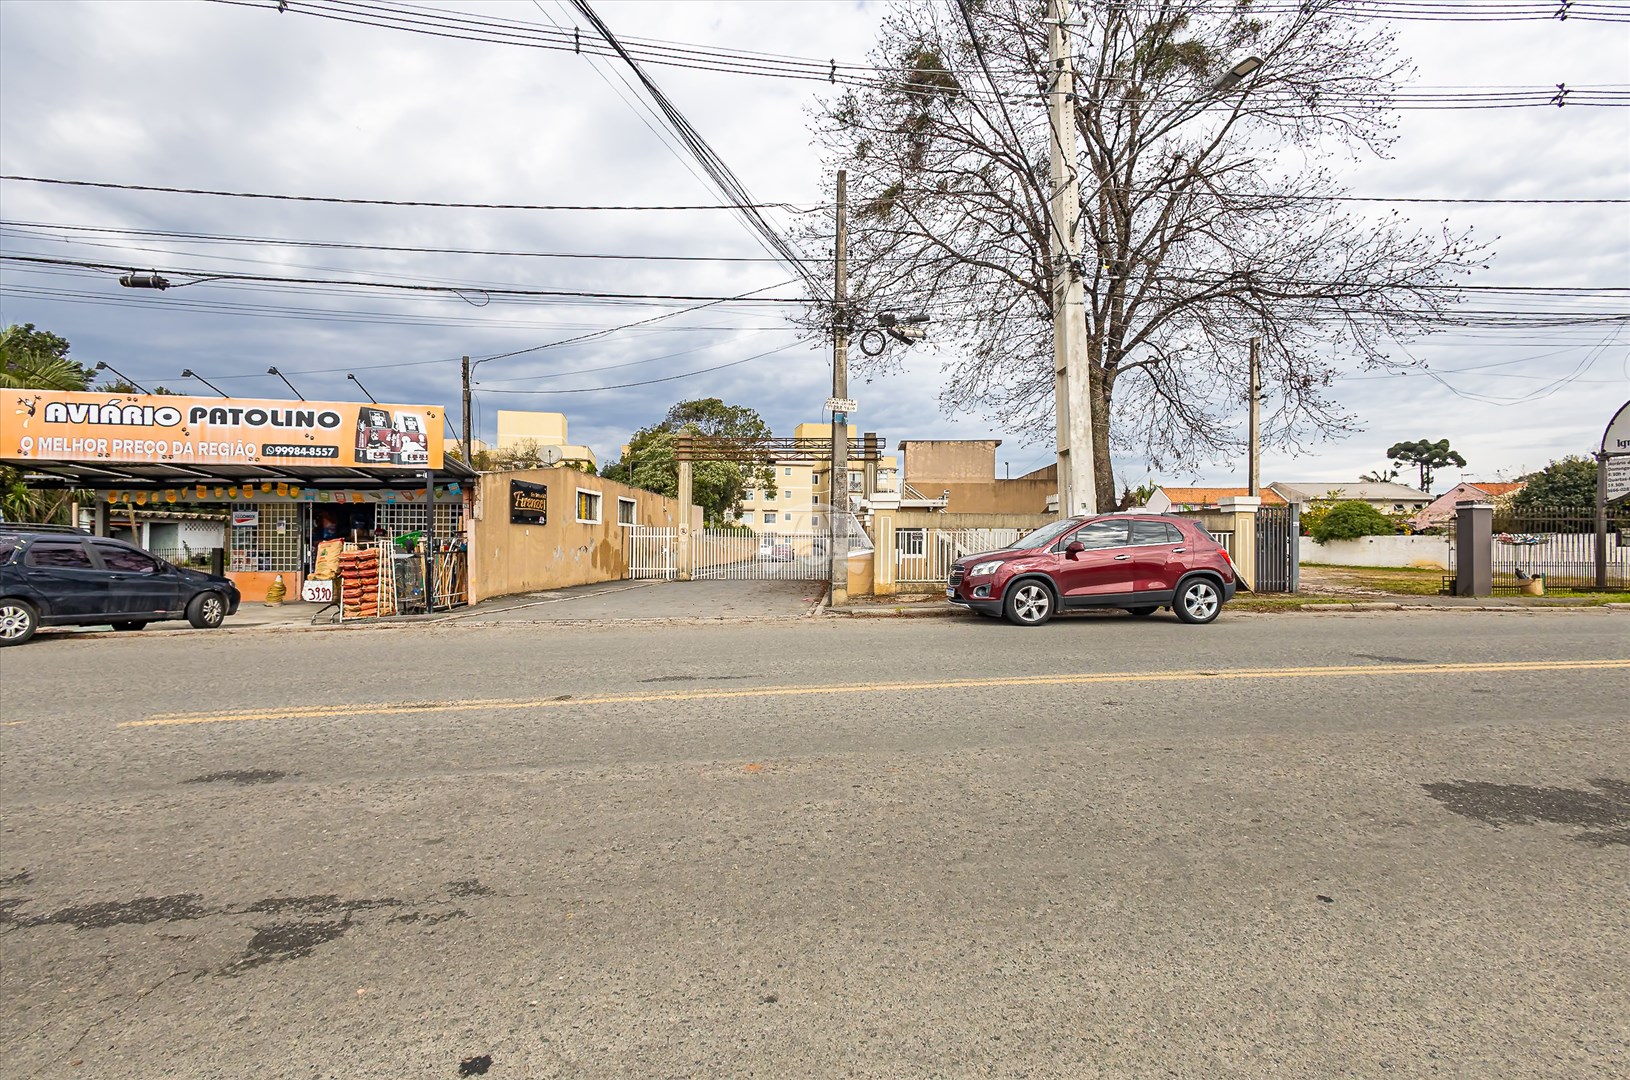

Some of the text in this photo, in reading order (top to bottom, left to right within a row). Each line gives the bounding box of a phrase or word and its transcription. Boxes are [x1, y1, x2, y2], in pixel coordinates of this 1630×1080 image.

[45, 399, 182, 427] AVIÁRIO
[189, 406, 341, 429] PATOLINO
[20, 436, 335, 457] O MELHOR PREÇO DA REGIÃO 99984-8557
[308, 587, 332, 601] 39,90
